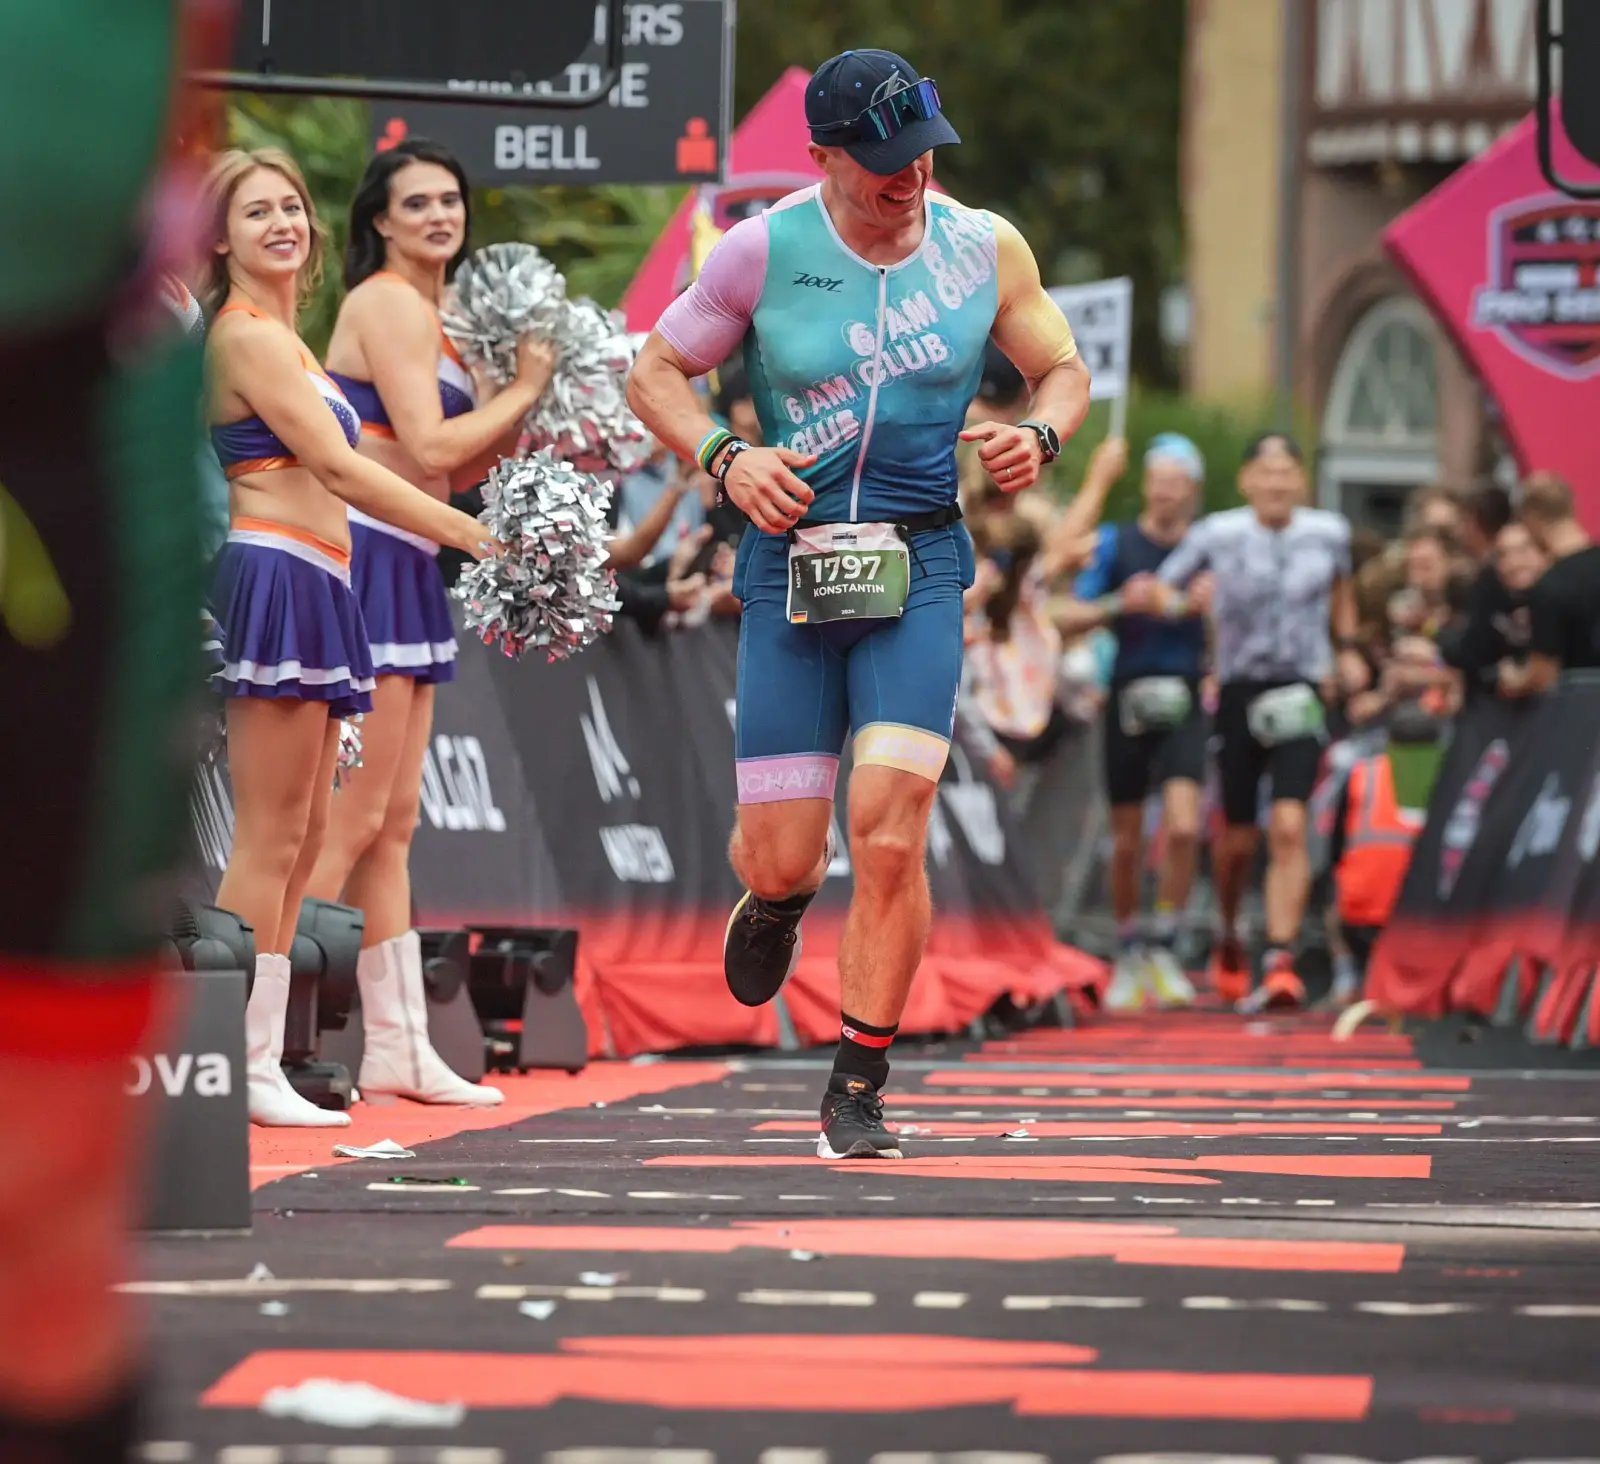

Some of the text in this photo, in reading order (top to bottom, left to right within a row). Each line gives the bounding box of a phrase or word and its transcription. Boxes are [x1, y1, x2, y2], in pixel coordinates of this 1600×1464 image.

[494, 125, 600, 169] BELL
[850, 290, 939, 356] 6 AM
[858, 333, 948, 386] CLUB
[786, 375, 856, 424] 6 AM
[811, 555, 881, 583] 1797
[813, 583, 885, 598] KONSTANTIN
